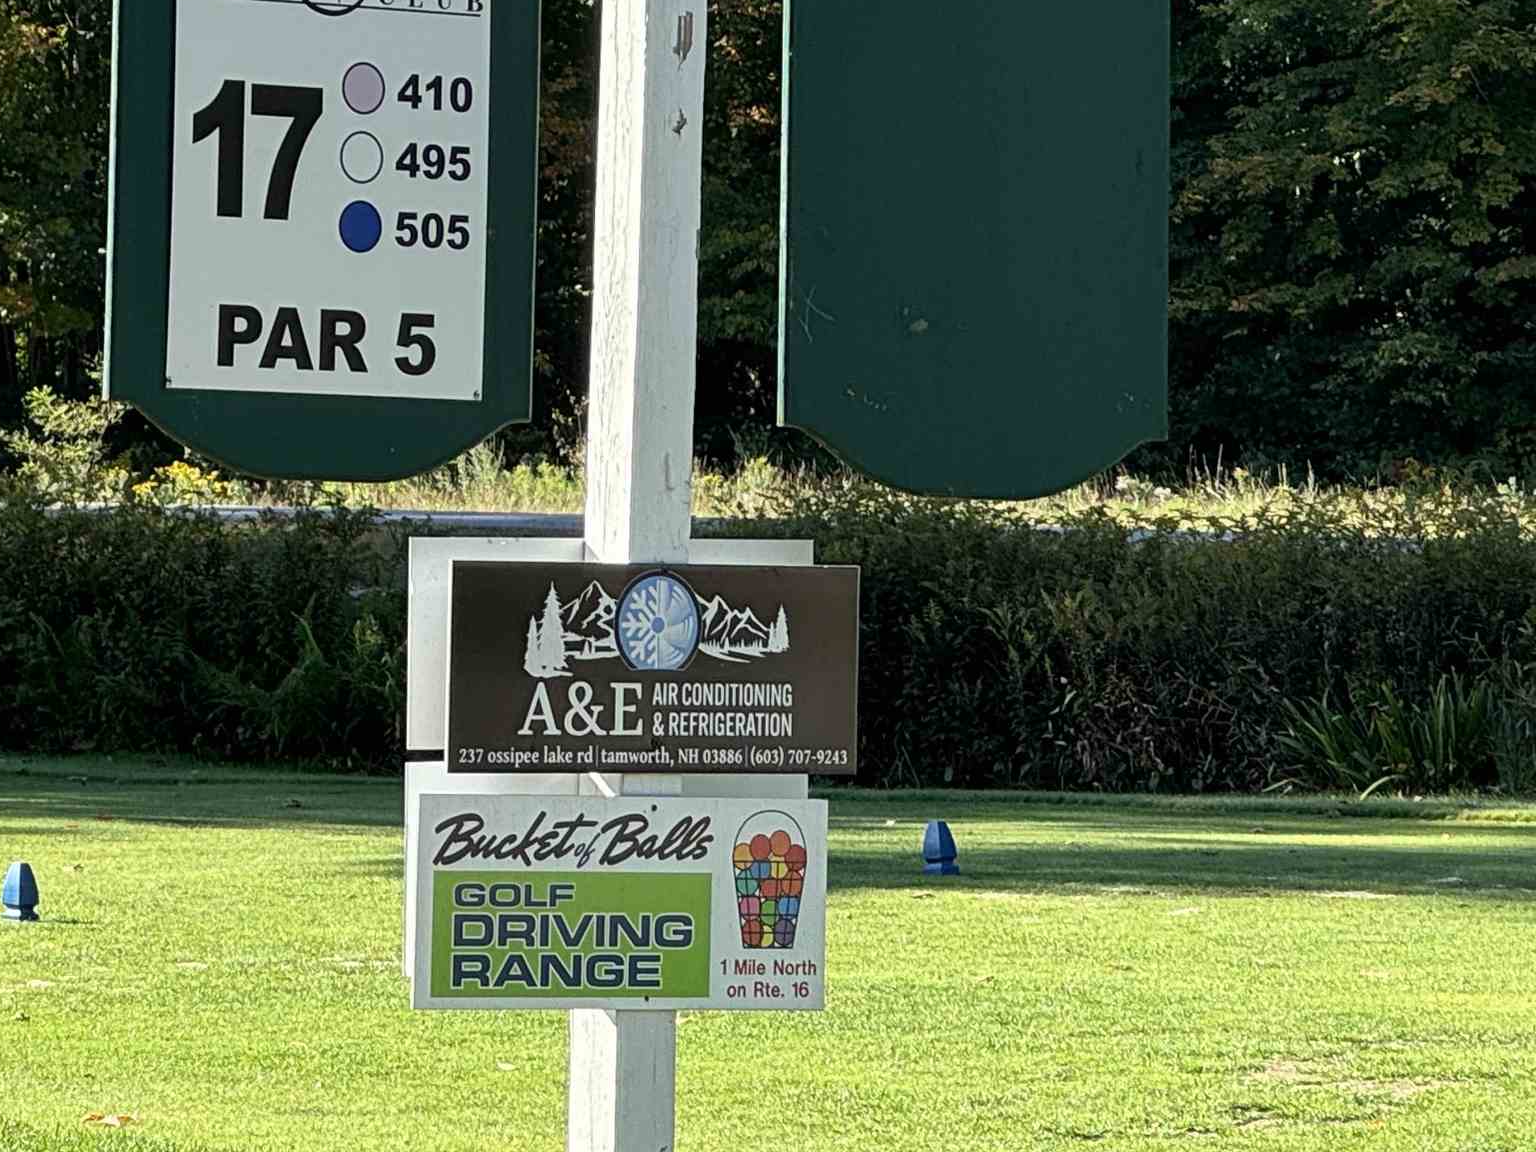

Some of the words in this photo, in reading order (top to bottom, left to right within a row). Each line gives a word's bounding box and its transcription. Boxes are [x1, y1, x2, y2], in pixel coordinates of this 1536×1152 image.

[397, 73, 473, 113] 410
[192, 79, 324, 221] 17
[395, 142, 471, 182] 495
[394, 211, 470, 250] 505
[217, 304, 369, 373] PAR
[394, 312, 436, 376] 5
[517, 680, 644, 736] A&E
[652, 682, 678, 705] AIR
[682, 682, 793, 707] CONDITIONING
[652, 714, 665, 736] &
[668, 712, 793, 736] REFRIGERATION
[458, 748, 484, 763] 237
[487, 746, 539, 768] ossipee
[543, 745, 572, 764] lake
[576, 745, 593, 764] rd
[601, 745, 675, 767] tamworth,
[678, 748, 699, 764] NH
[703, 748, 743, 764] 03886
[750, 746, 785, 767] (603)
[788, 749, 848, 765] 707-9243
[433, 811, 598, 867] Bucket
[574, 832, 601, 868] of
[599, 814, 714, 865] Balls
[454, 881, 575, 908] GOLF
[452, 912, 694, 949] DRIVING
[450, 953, 663, 989] RANGE
[720, 959, 728, 975] 1
[734, 959, 765, 976] Mile
[773, 959, 817, 976] North
[727, 983, 747, 998] on
[753, 981, 785, 998] Rte.
[791, 982, 809, 998] 16
